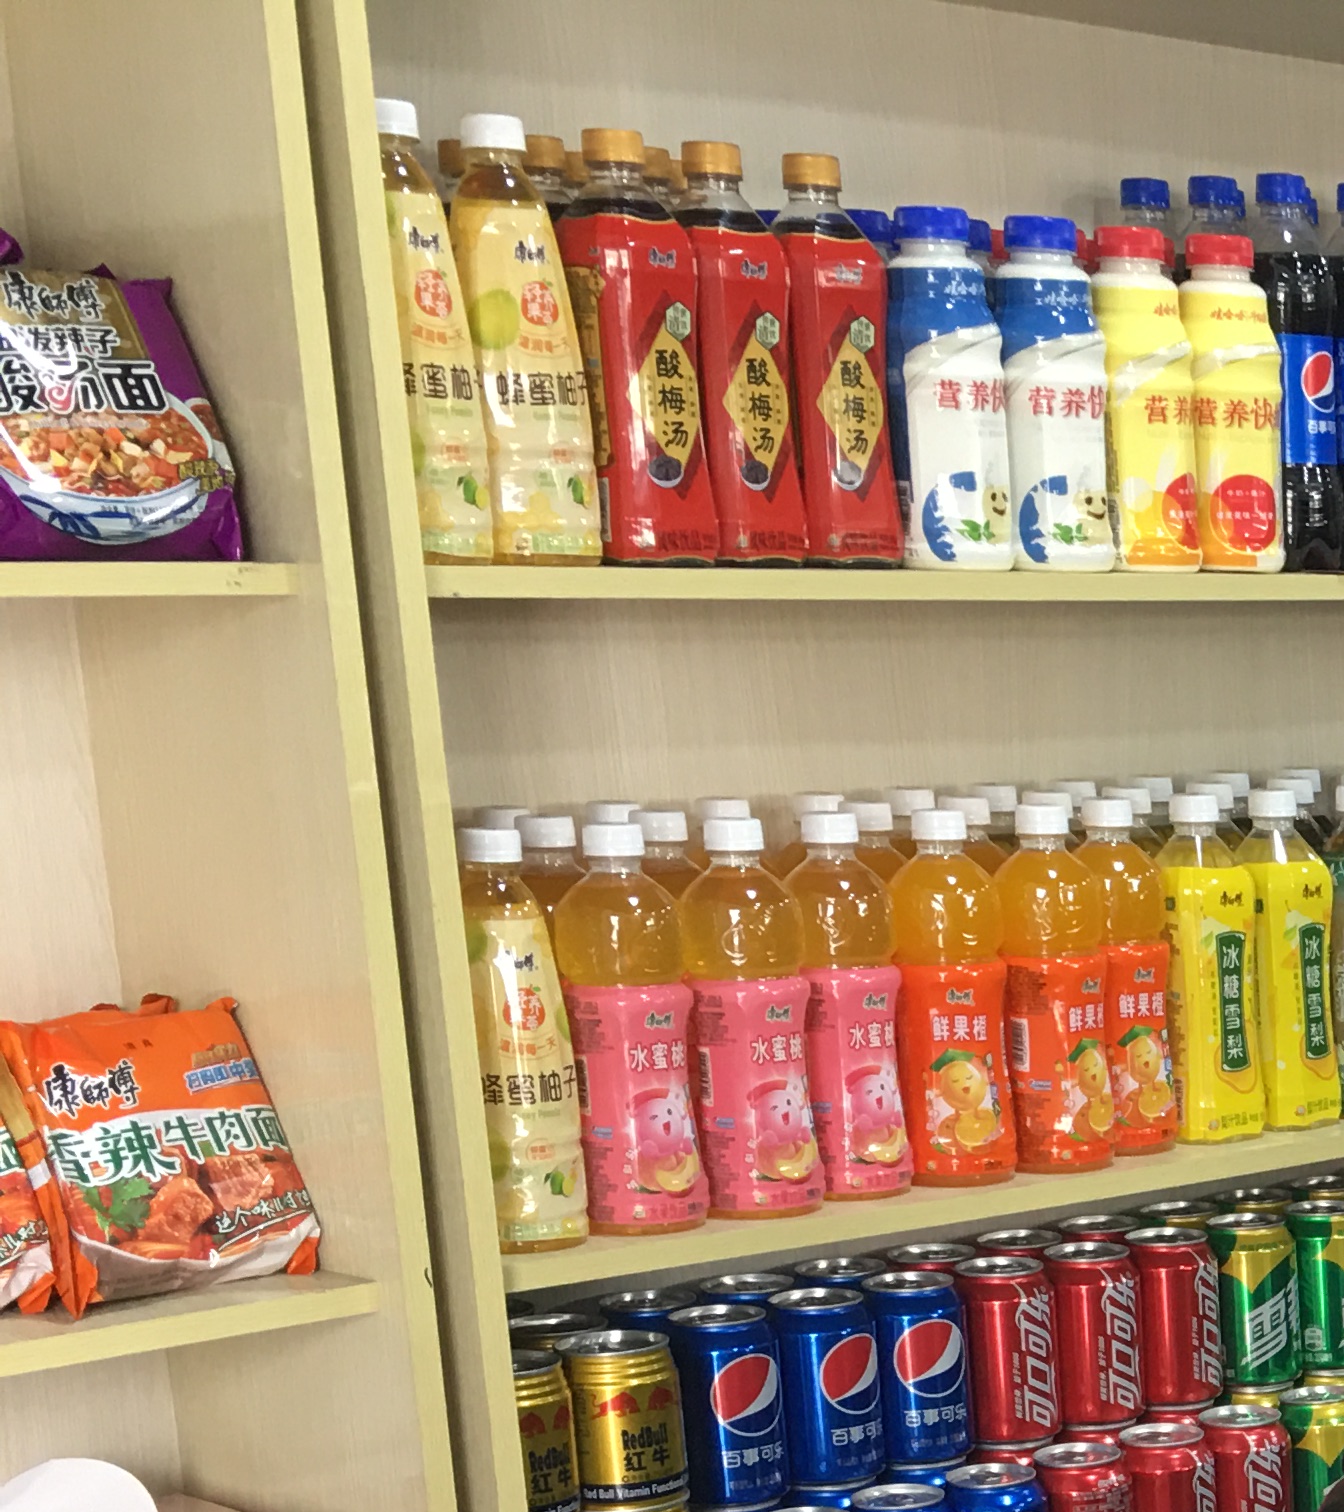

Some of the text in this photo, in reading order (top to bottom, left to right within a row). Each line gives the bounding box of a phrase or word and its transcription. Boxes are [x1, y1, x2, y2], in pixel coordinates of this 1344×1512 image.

[655, 349, 689, 448] 酸梅汤
[745, 358, 775, 454] 酸梅汤
[839, 360, 869, 455] 酸梅汤
[1195, 395, 1281, 430] 营养快
[1118, 991, 1165, 1019] 鲜果橙
[1222, 943, 1244, 1060] 冰糖雪梨
[1304, 935, 1325, 1047] 冰糖雪梨
[849, 1022, 897, 1051] 水蜜桃
[931, 1014, 988, 1043] 鲜果橙
[629, 1039, 686, 1073] 水蜜桃
[751, 1034, 804, 1065] 水蜜桃
[46, 1105, 290, 1186] 香辣牛肉面
[1015, 1284, 1053, 1428] 可口可乐
[1101, 1269, 1140, 1410] 可口可乐
[905, 1403, 968, 1431] 百事可乐
[621, 1422, 669, 1450] RedBull
[623, 1448, 671, 1472] 红牛
[722, 1441, 785, 1470] 百事可乐
